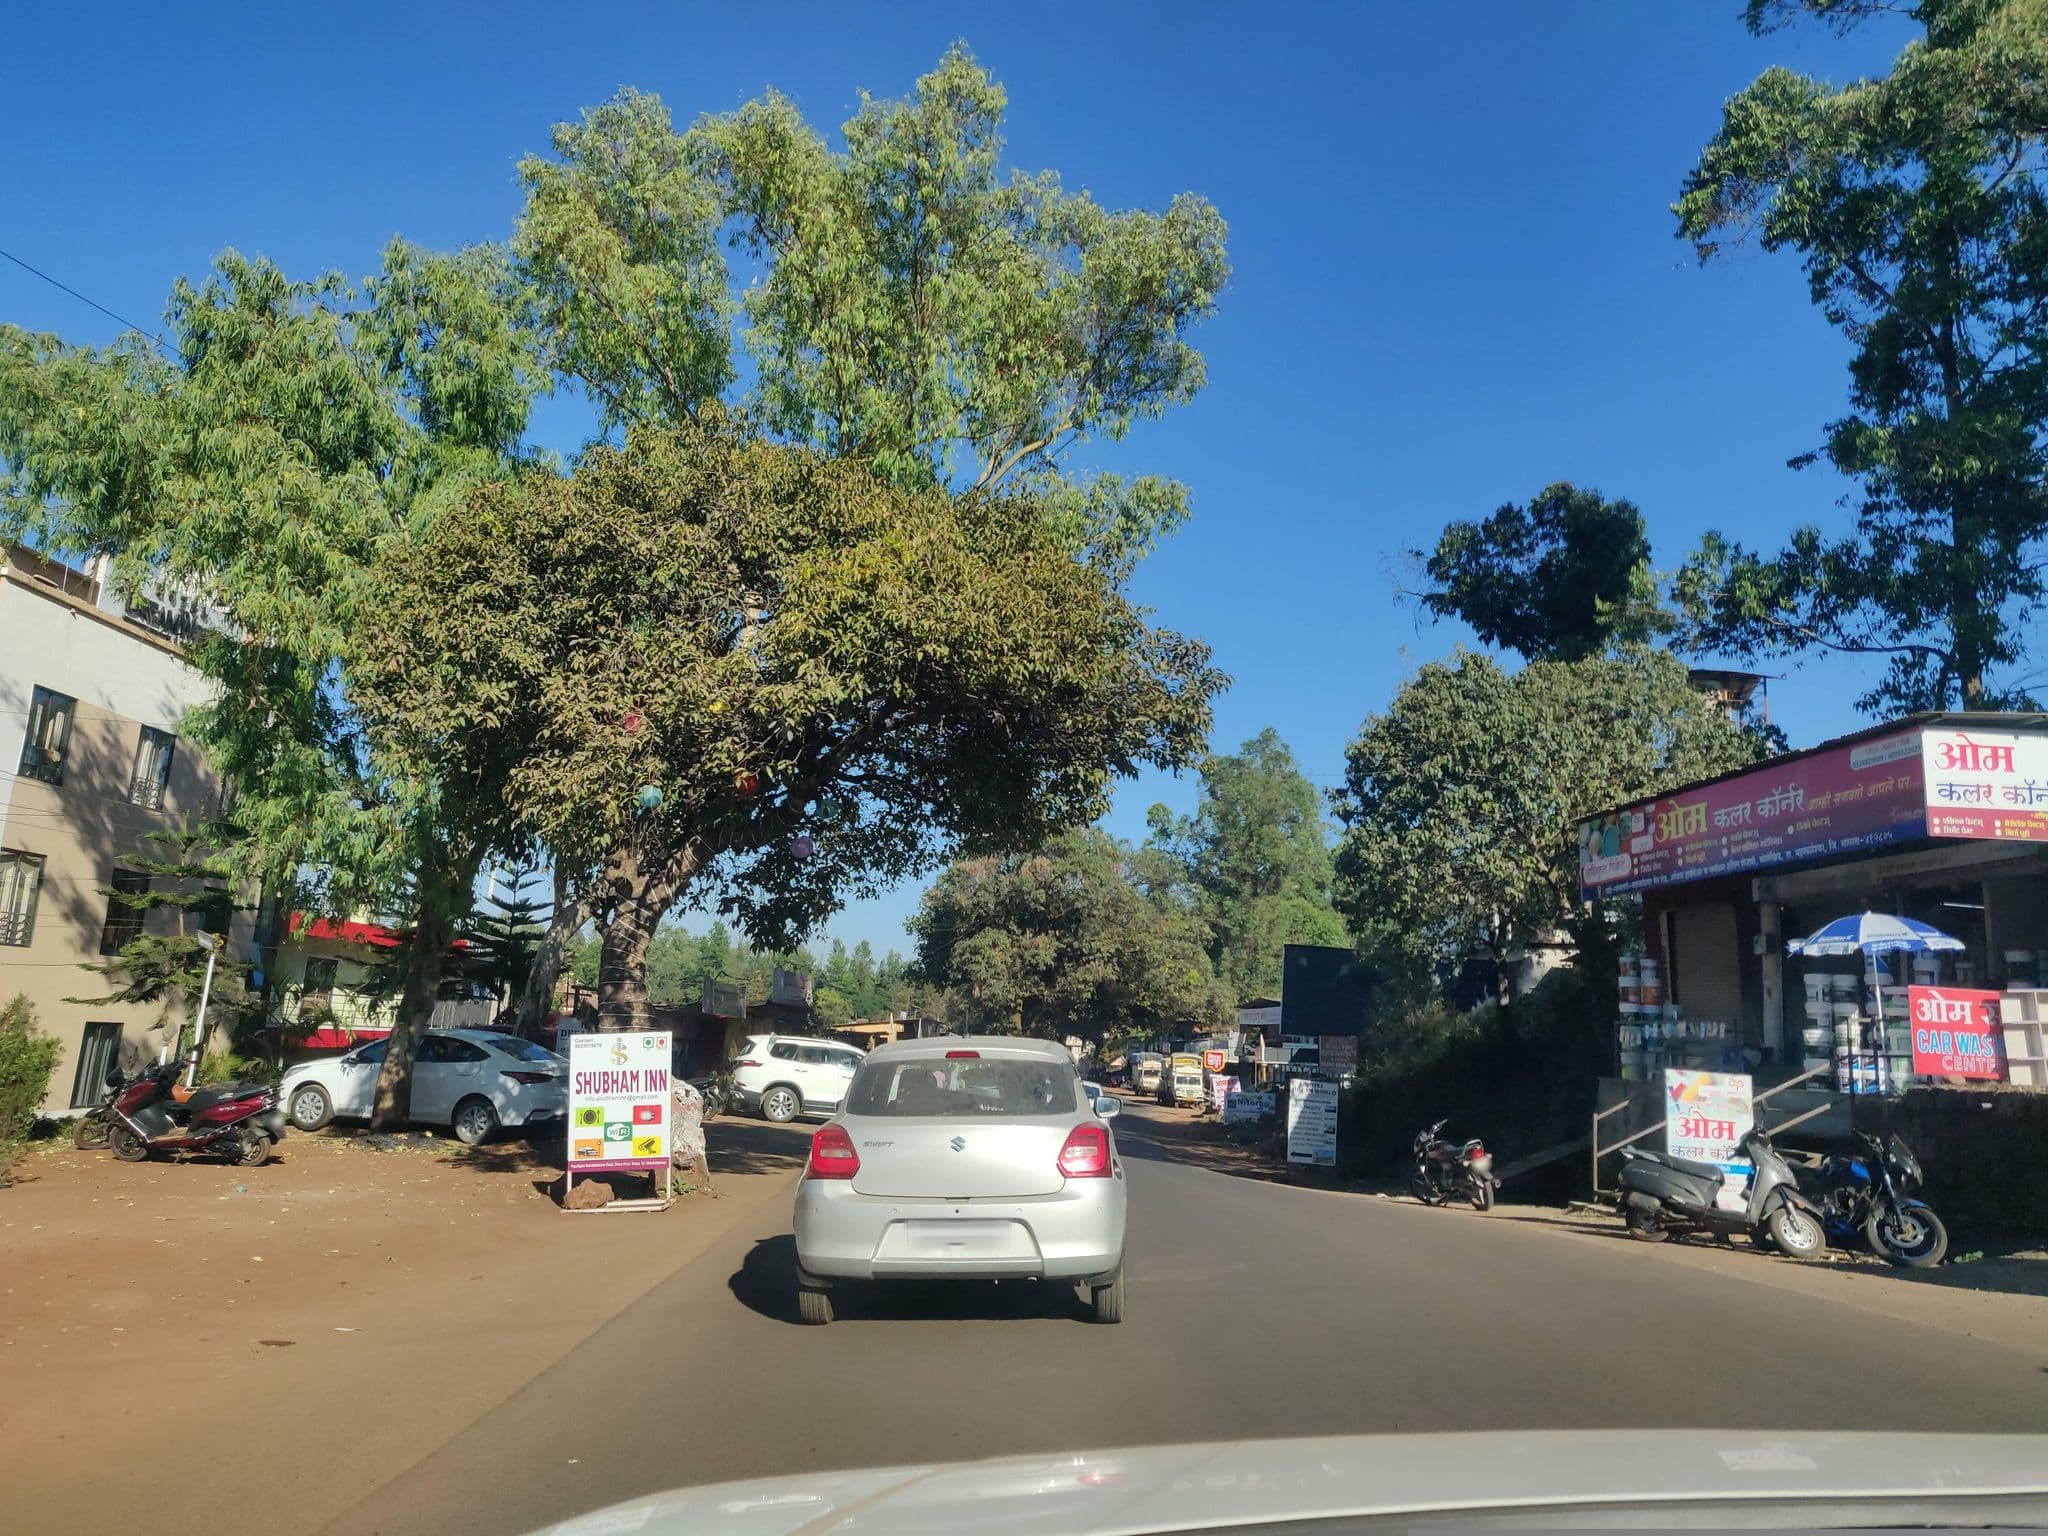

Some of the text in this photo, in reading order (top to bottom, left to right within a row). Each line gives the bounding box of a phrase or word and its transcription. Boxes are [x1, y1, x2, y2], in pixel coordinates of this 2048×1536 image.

[1935, 732, 2015, 773] ओम
[1936, 782, 1993, 805] कलर
[1655, 783, 1805, 843] ओम कलर कॉर्नर
[1916, 990, 1973, 1025] ओम
[1917, 1029, 1953, 1055] CAR
[575, 1068, 668, 1095] SHUBHAM INN
[1675, 1110, 1736, 1141] ओम
[1671, 1145, 1705, 1160] कलर
